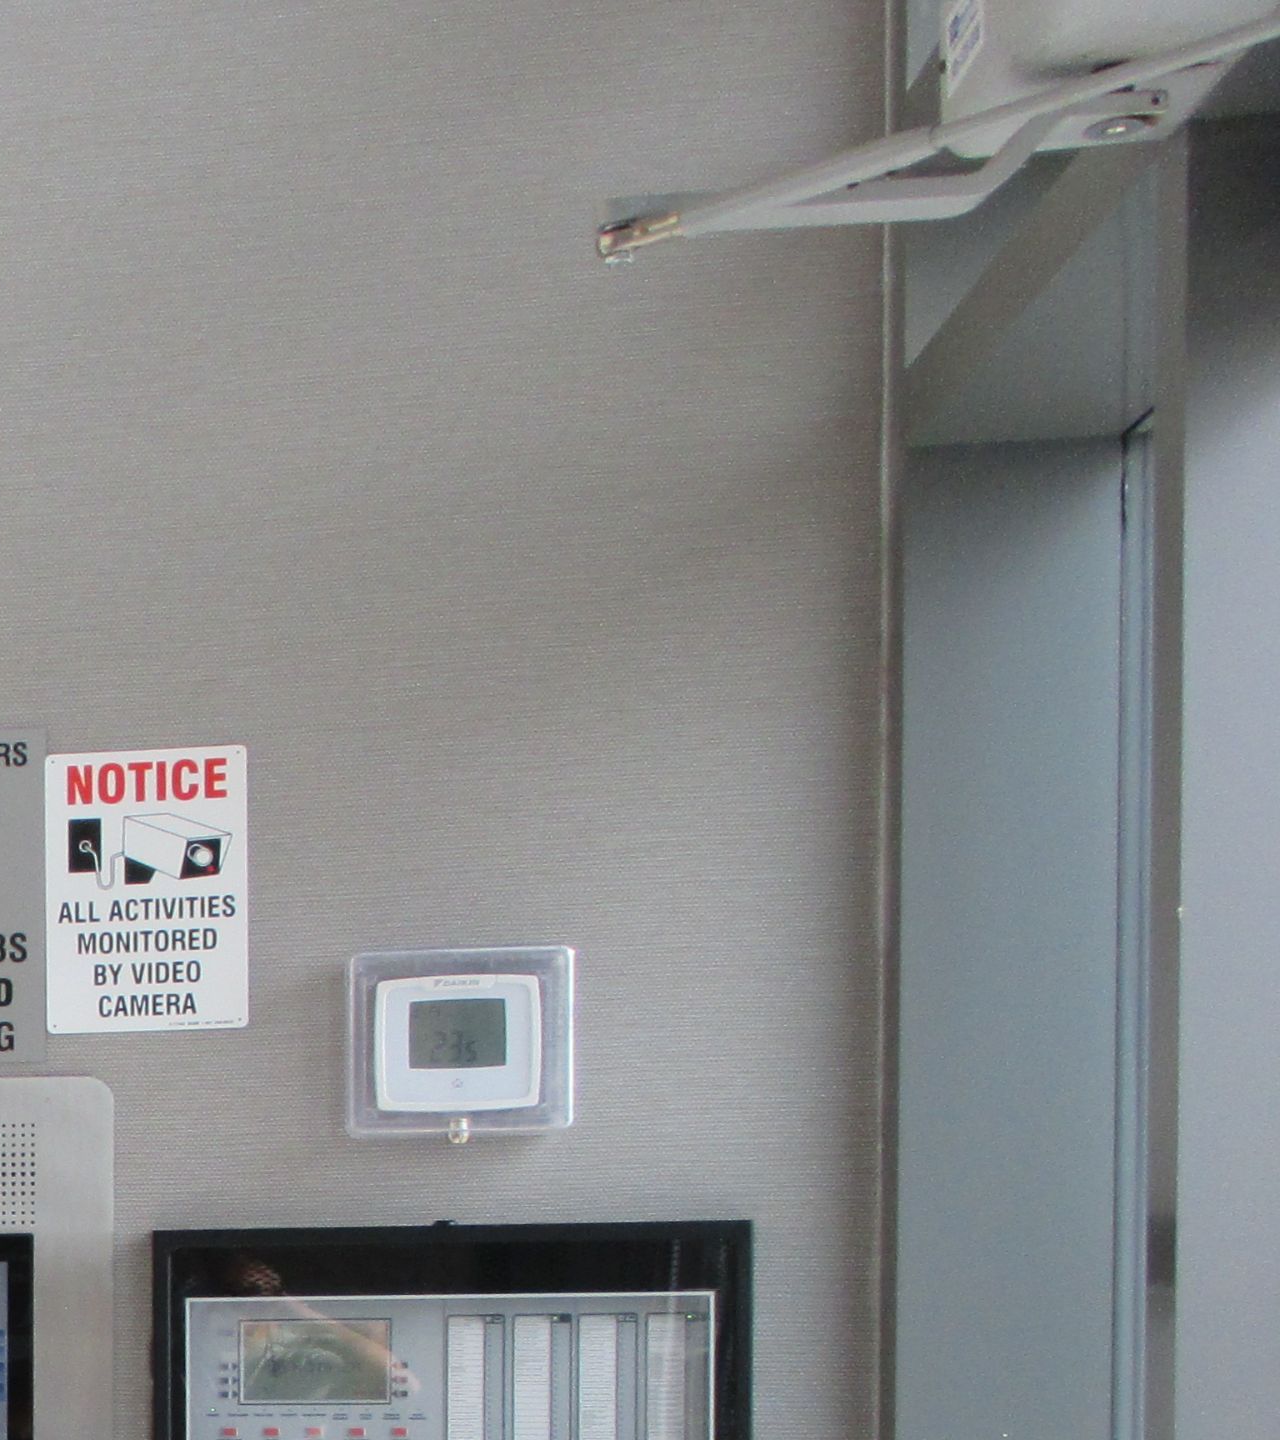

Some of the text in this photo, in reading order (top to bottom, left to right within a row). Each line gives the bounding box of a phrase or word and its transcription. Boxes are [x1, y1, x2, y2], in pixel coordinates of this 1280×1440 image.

[67, 758, 228, 805] NOTICE
[58, 895, 236, 924] ALL ACTIVITIES
[77, 928, 218, 954] MONITORED
[94, 960, 201, 986] BY VIDEO
[98, 993, 197, 1018] CAMERA
